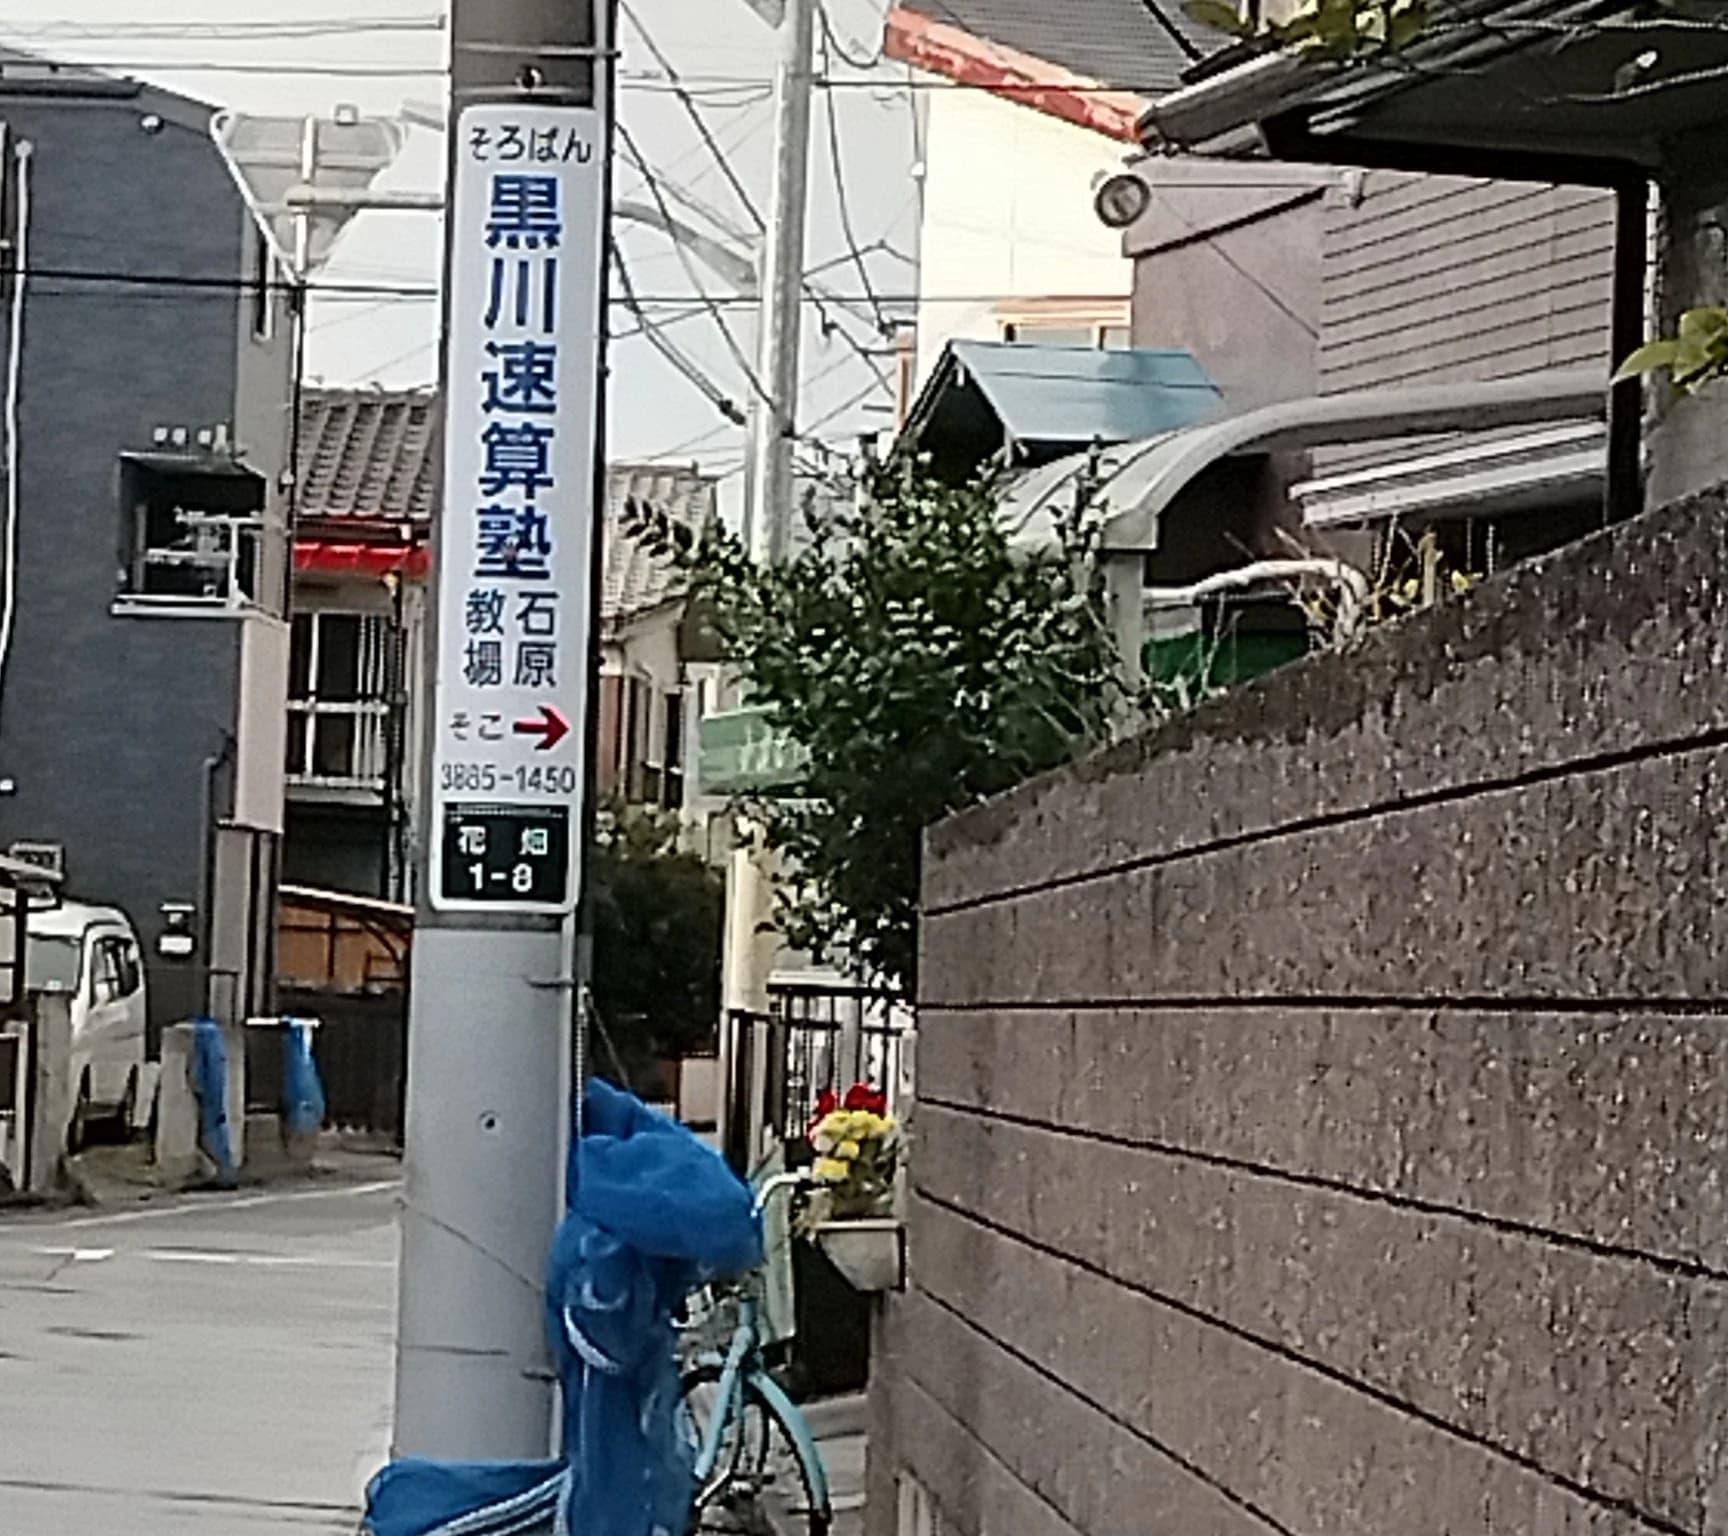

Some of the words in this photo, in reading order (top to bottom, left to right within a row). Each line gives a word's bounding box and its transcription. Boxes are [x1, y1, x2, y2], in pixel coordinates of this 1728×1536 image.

[470, 126, 591, 163] そろばん
[474, 174, 562, 579] 黒川速算塾
[463, 588, 506, 687] 教場
[513, 591, 559, 687] 石原
[468, 862, 533, 893] 1-8
